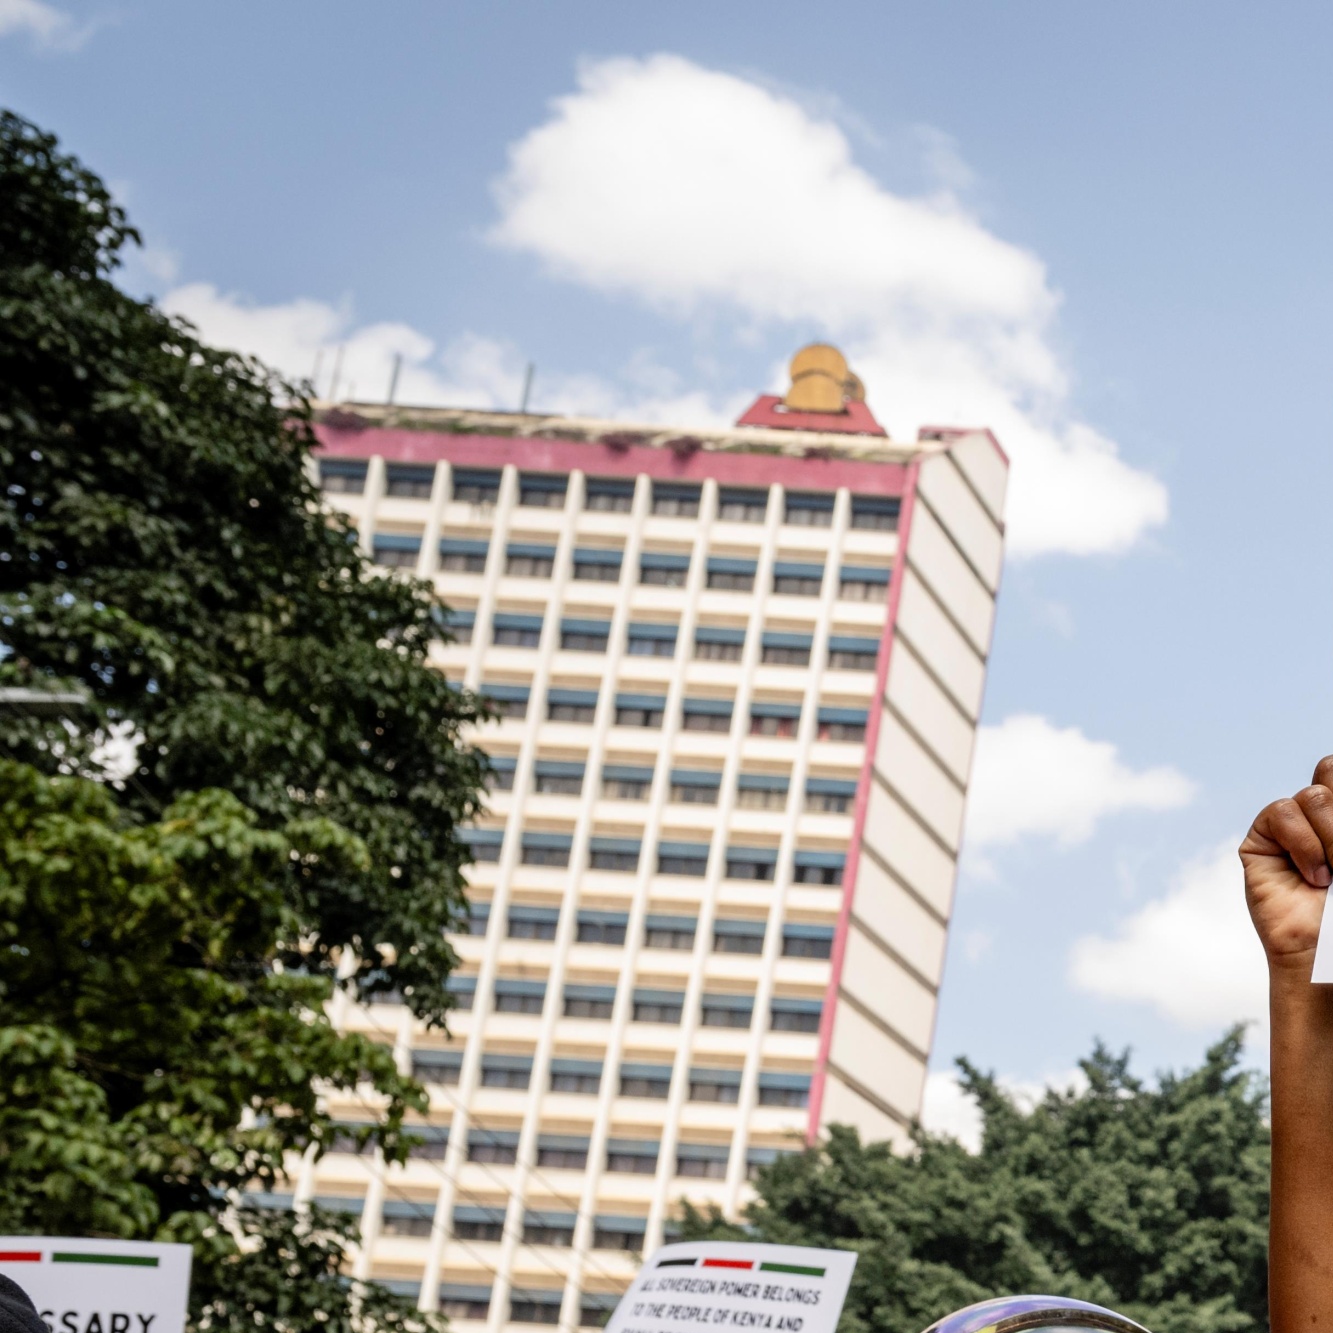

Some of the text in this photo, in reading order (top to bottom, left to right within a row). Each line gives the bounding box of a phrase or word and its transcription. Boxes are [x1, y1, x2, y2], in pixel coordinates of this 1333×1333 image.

[718, 1281, 758, 1298] POWER
[761, 1284, 822, 1305] BELONGS
[645, 1303, 663, 1319] THE
[666, 1305, 712, 1323] PEOPLE
[713, 1308, 727, 1325] OF
[730, 1310, 772, 1329] KENYA
[776, 1315, 805, 1333] AND
